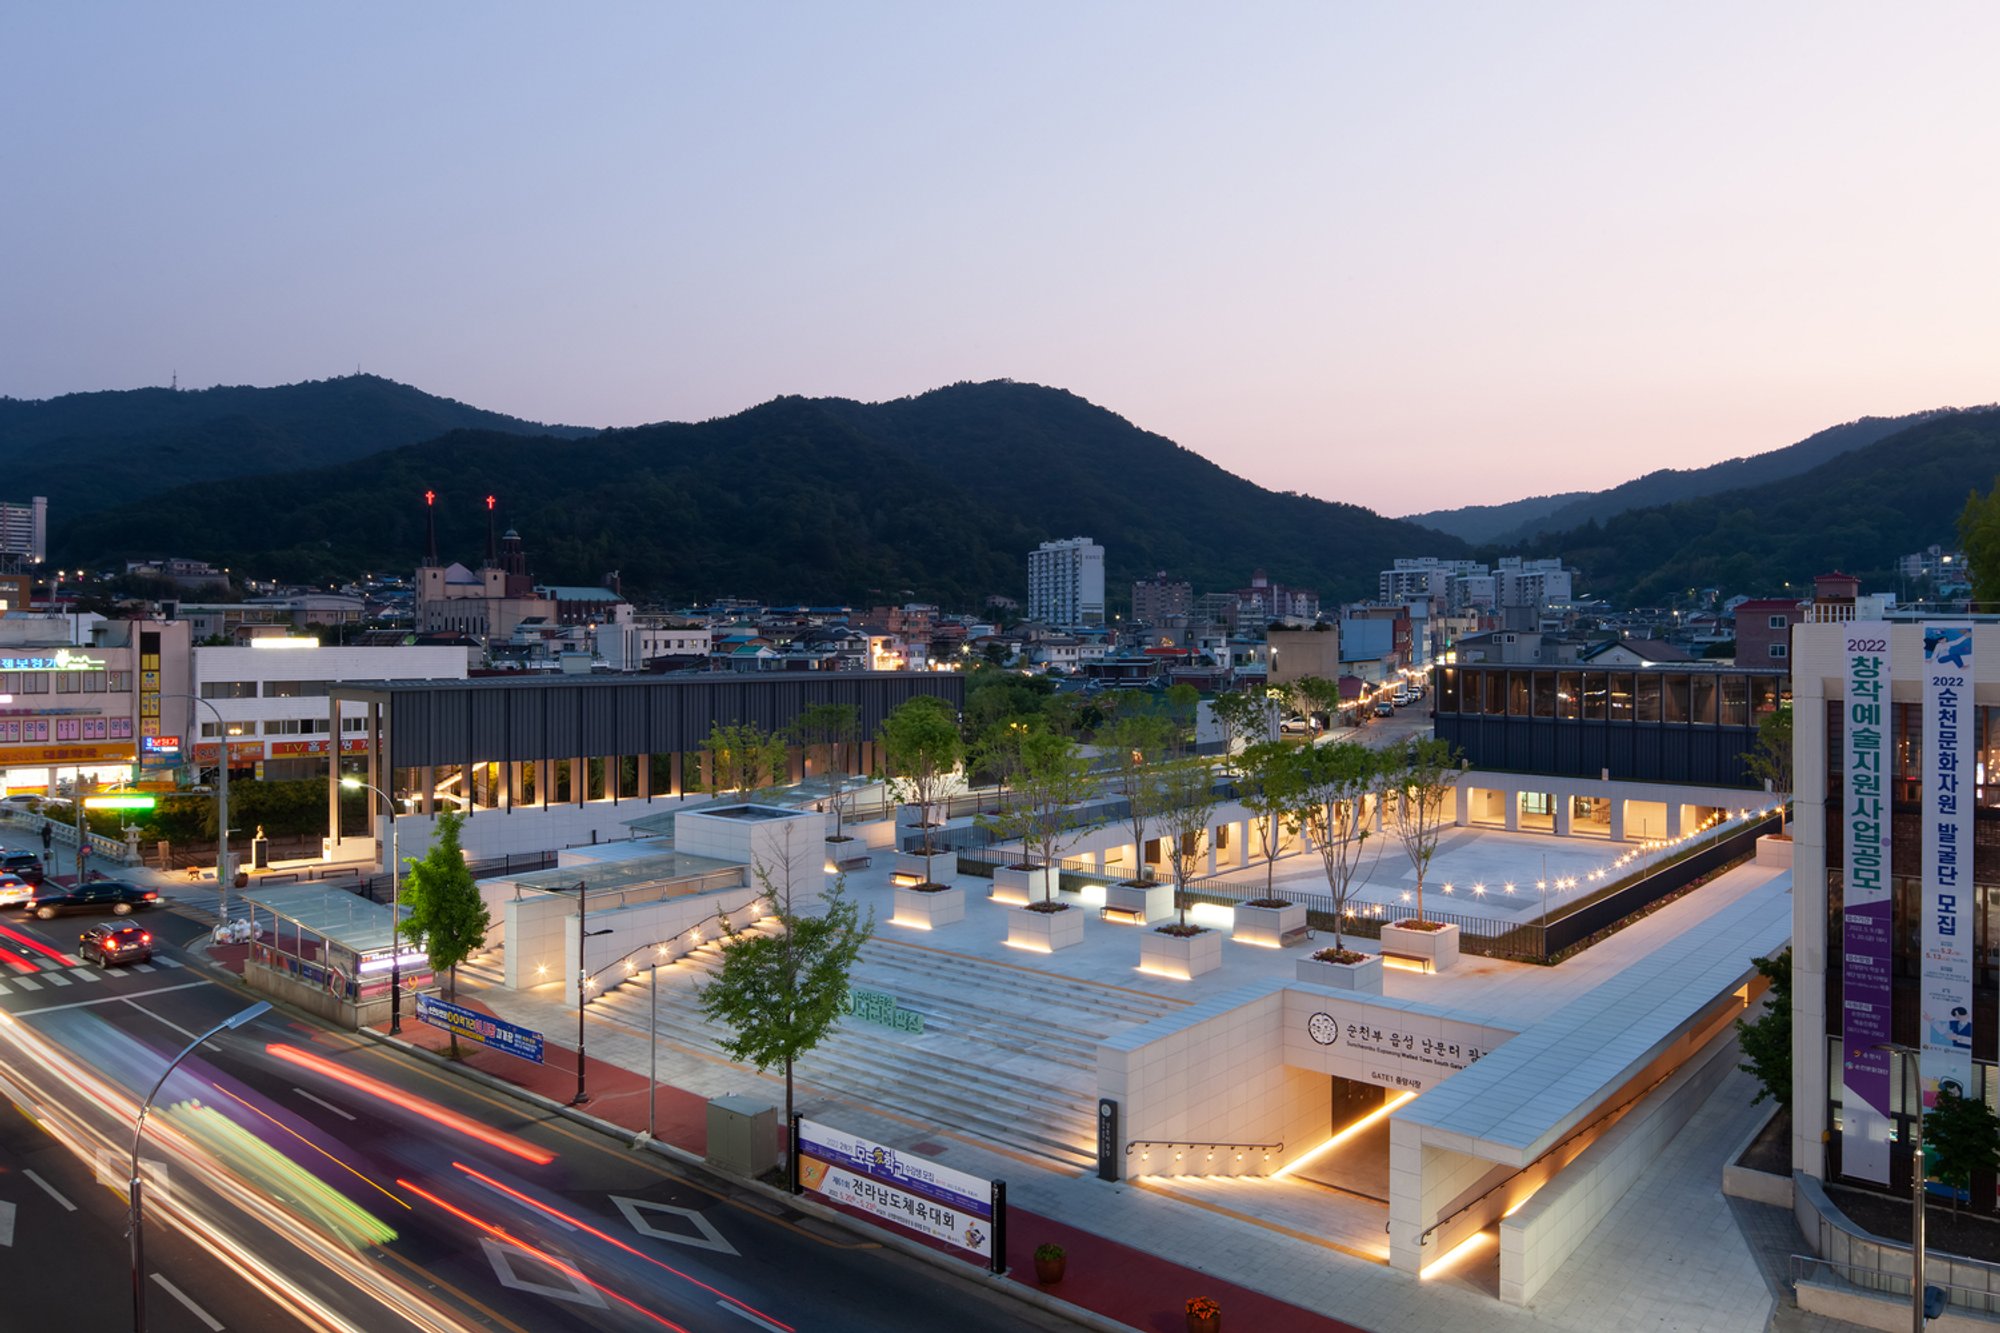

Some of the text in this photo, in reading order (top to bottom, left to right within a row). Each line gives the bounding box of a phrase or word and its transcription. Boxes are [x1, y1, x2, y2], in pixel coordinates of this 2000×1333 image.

[1848, 639, 1887, 652] 2022
[1932, 676, 1965, 687] 2022
[284, 743, 303, 753] TV
[1937, 688, 1959, 815] 순천문화자원
[1850, 656, 1885, 891] 창작예술지원사업공모
[1937, 822, 1958, 886] 발굴단
[1937, 894, 1957, 937] 모집
[1346, 1024, 1488, 1063] 순천부 읍성 남문터 광
[1371, 1071, 1394, 1084] GATE1
[1434, 1059, 1449, 1067] South
[1450, 1062, 1463, 1070] Gate
[852, 1178, 955, 1231] 전라남도체육대회
